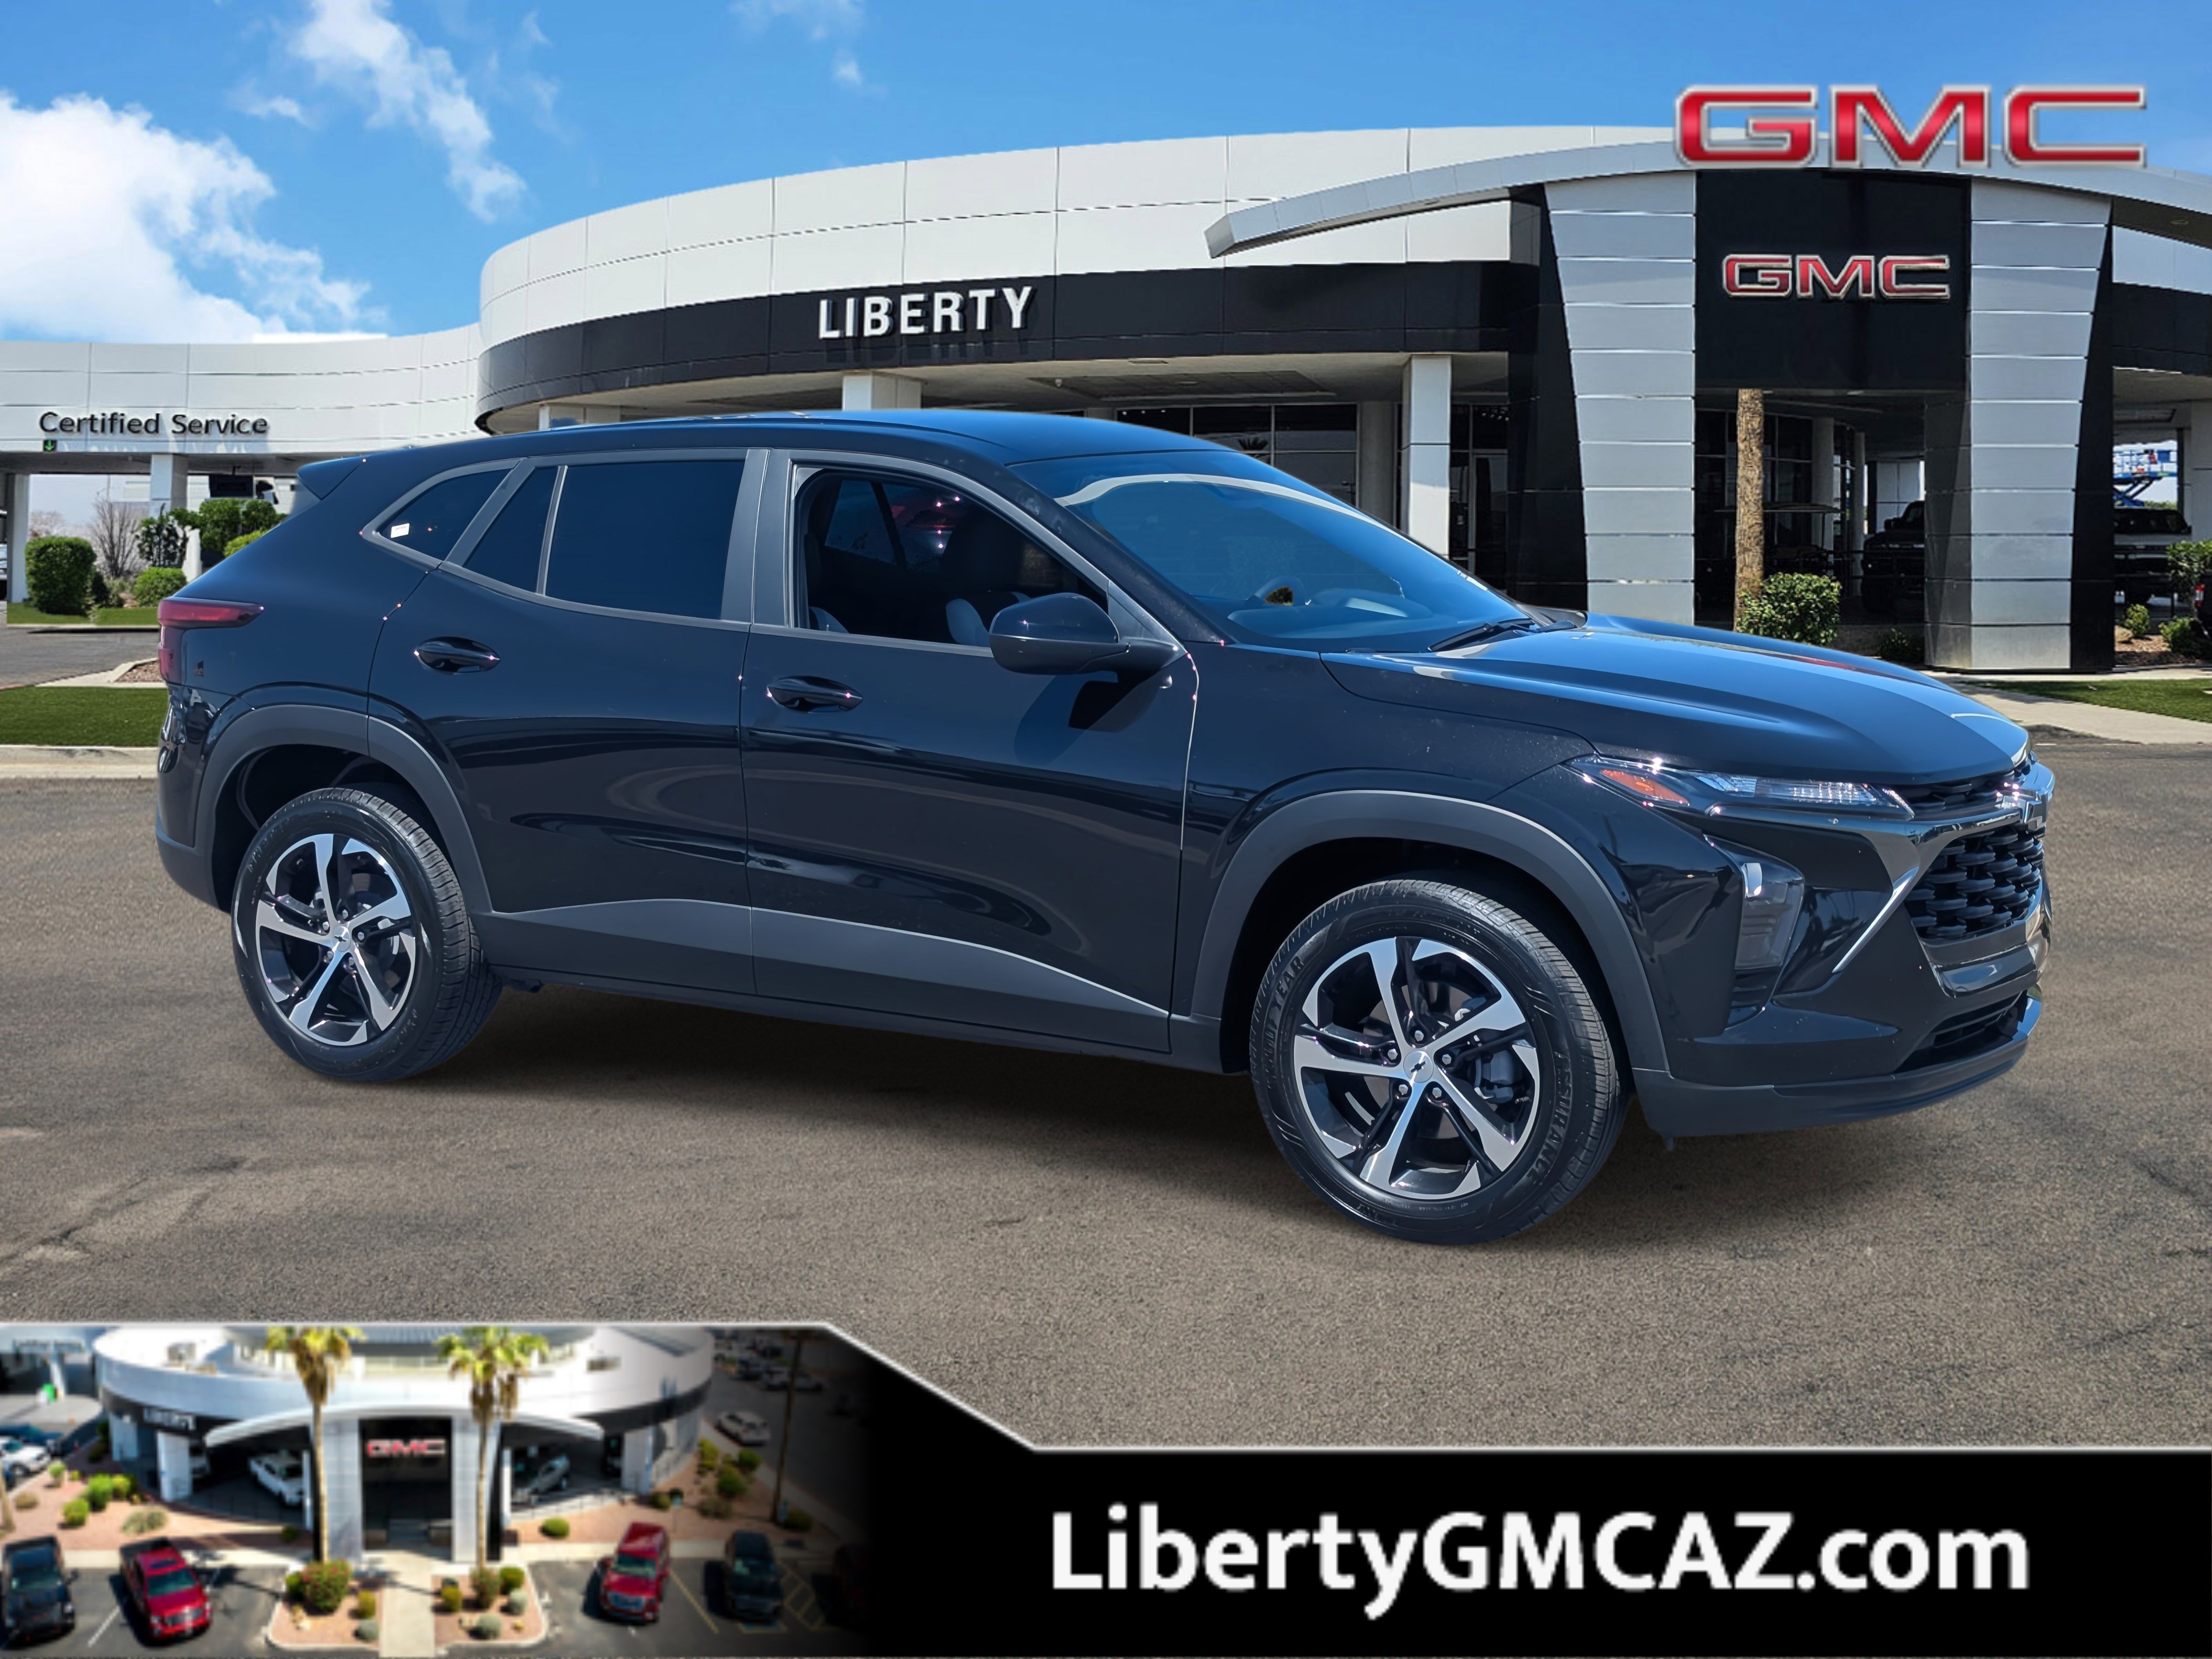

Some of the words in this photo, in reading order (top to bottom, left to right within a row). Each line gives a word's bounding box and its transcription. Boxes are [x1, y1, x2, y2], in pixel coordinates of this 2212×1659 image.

[1723, 254, 1950, 299] GMC
[819, 286, 1032, 339] LIBERTY
[39, 412, 160, 434] Certified
[171, 414, 268, 435] Service
